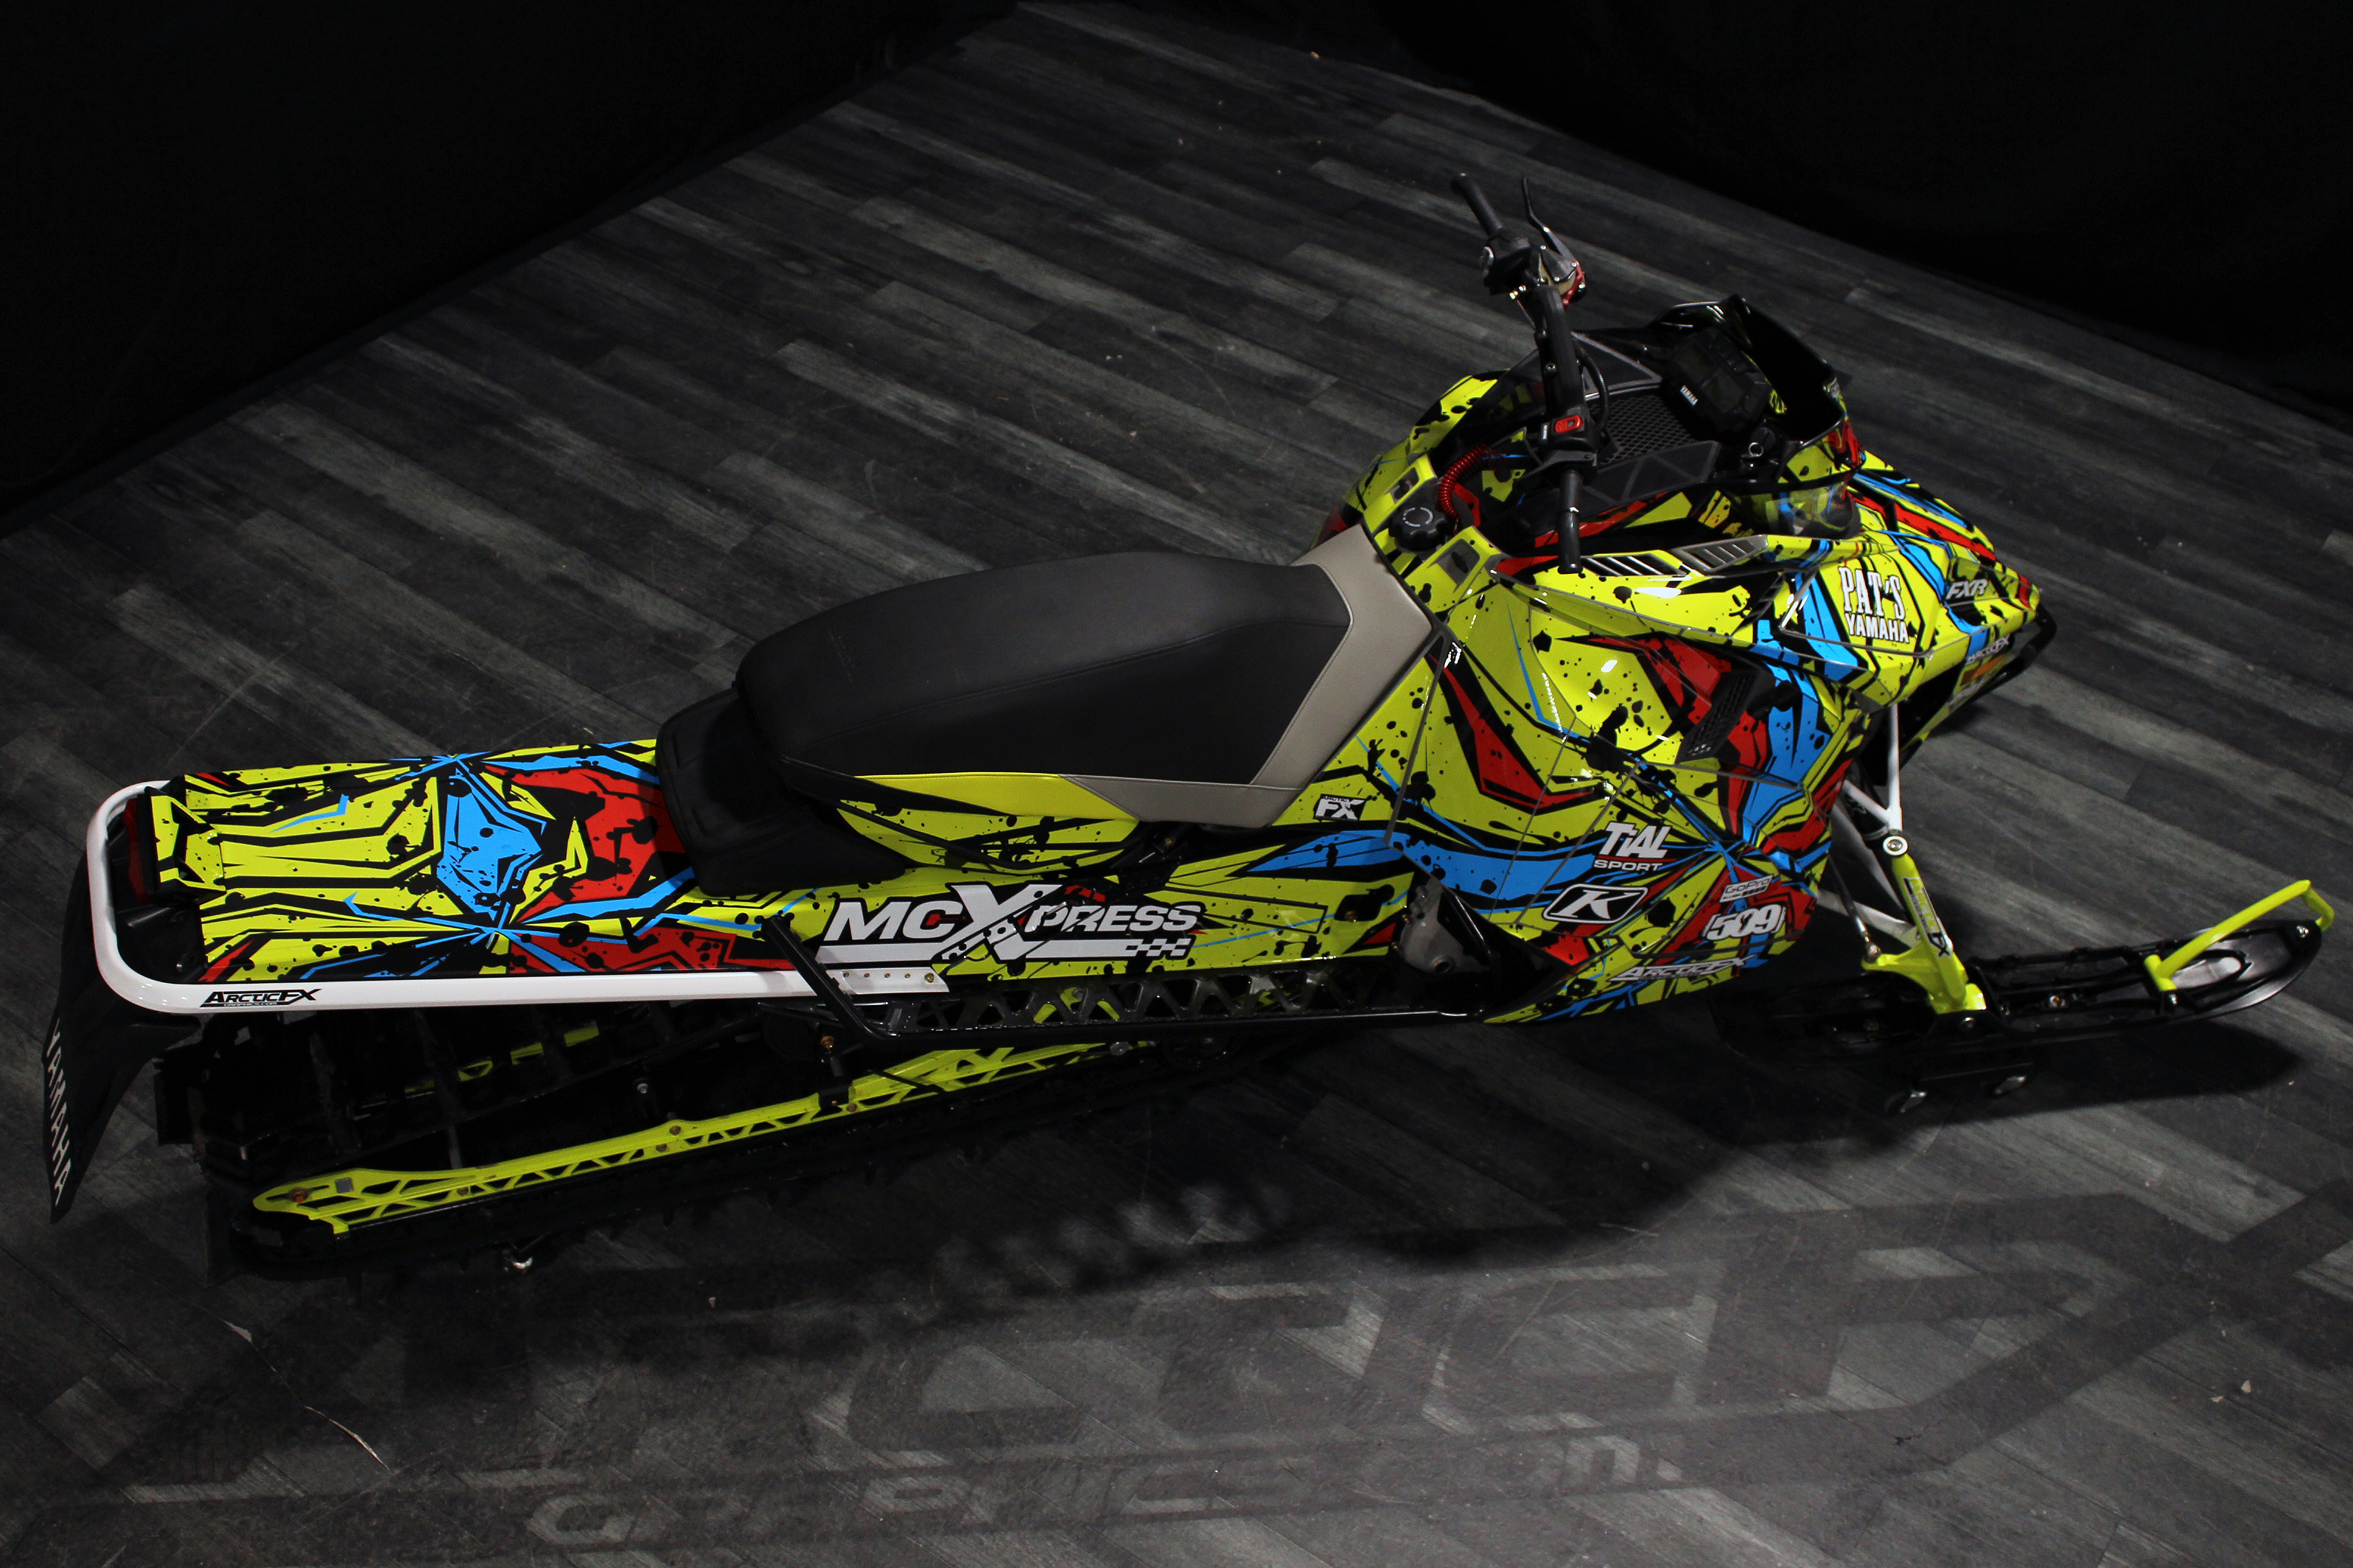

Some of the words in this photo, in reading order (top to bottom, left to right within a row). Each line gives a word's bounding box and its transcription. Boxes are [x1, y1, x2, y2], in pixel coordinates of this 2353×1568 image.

[1838, 566, 1906, 620] PAT'S
[1945, 578, 1990, 600] FXR
[1845, 613, 1910, 644] YAMAHA
[1315, 799, 1366, 820] FX
[1593, 859, 1663, 872] SPORT
[1705, 903, 1783, 941] 509
[46, 1017, 72, 1207] YAMAHA
